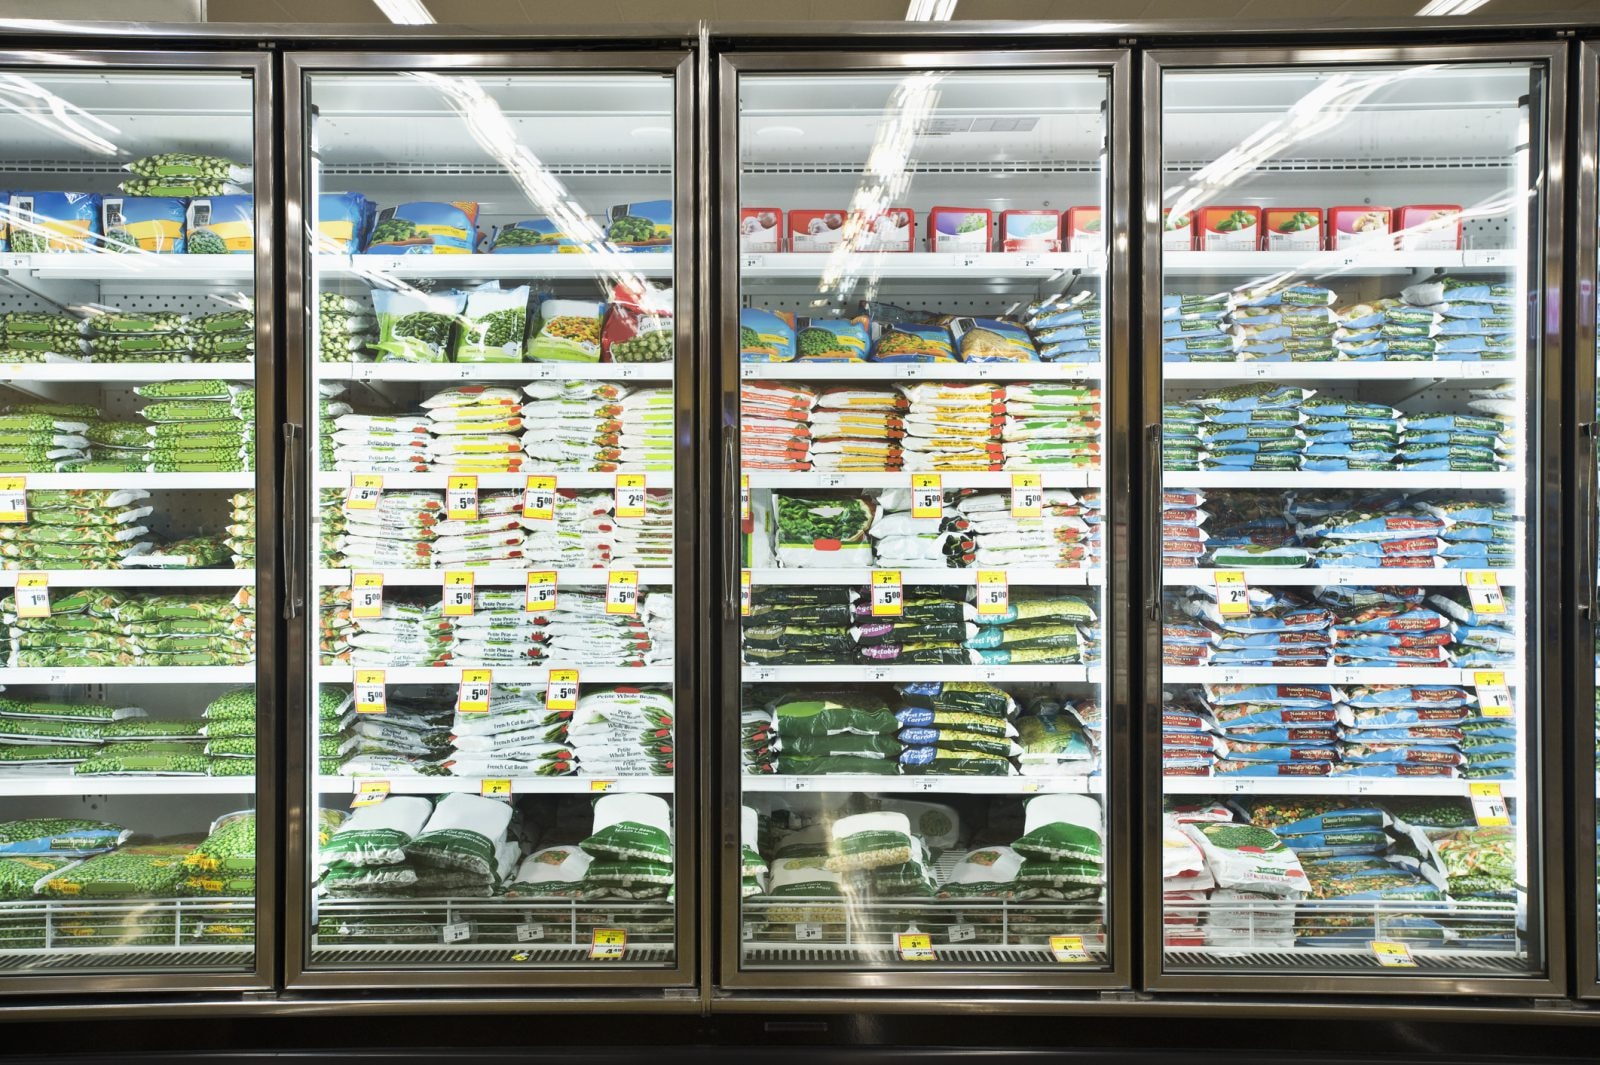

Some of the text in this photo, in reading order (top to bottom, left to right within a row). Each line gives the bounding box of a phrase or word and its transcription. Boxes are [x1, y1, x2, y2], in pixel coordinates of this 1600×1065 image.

[11, 499, 24, 510] 199
[460, 497, 475, 509] 500
[536, 497, 553, 508] 500
[628, 494, 643, 506] 249
[925, 495, 940, 506] 500
[1025, 495, 1041, 506] 500
[31, 595, 46, 605] 169
[365, 594, 381, 605] 500
[456, 593, 472, 604] 500
[539, 590, 555, 601] 500
[619, 592, 635, 603] 500
[885, 591, 900, 603] 500
[991, 591, 1006, 603] 500
[1231, 590, 1246, 602] 249
[368, 692, 383, 702] 500
[472, 689, 488, 700] 500
[560, 688, 576, 699] 500
[1494, 694, 1508, 706] 199
[494, 721, 511, 729] French
[1490, 805, 1504, 817] 169
